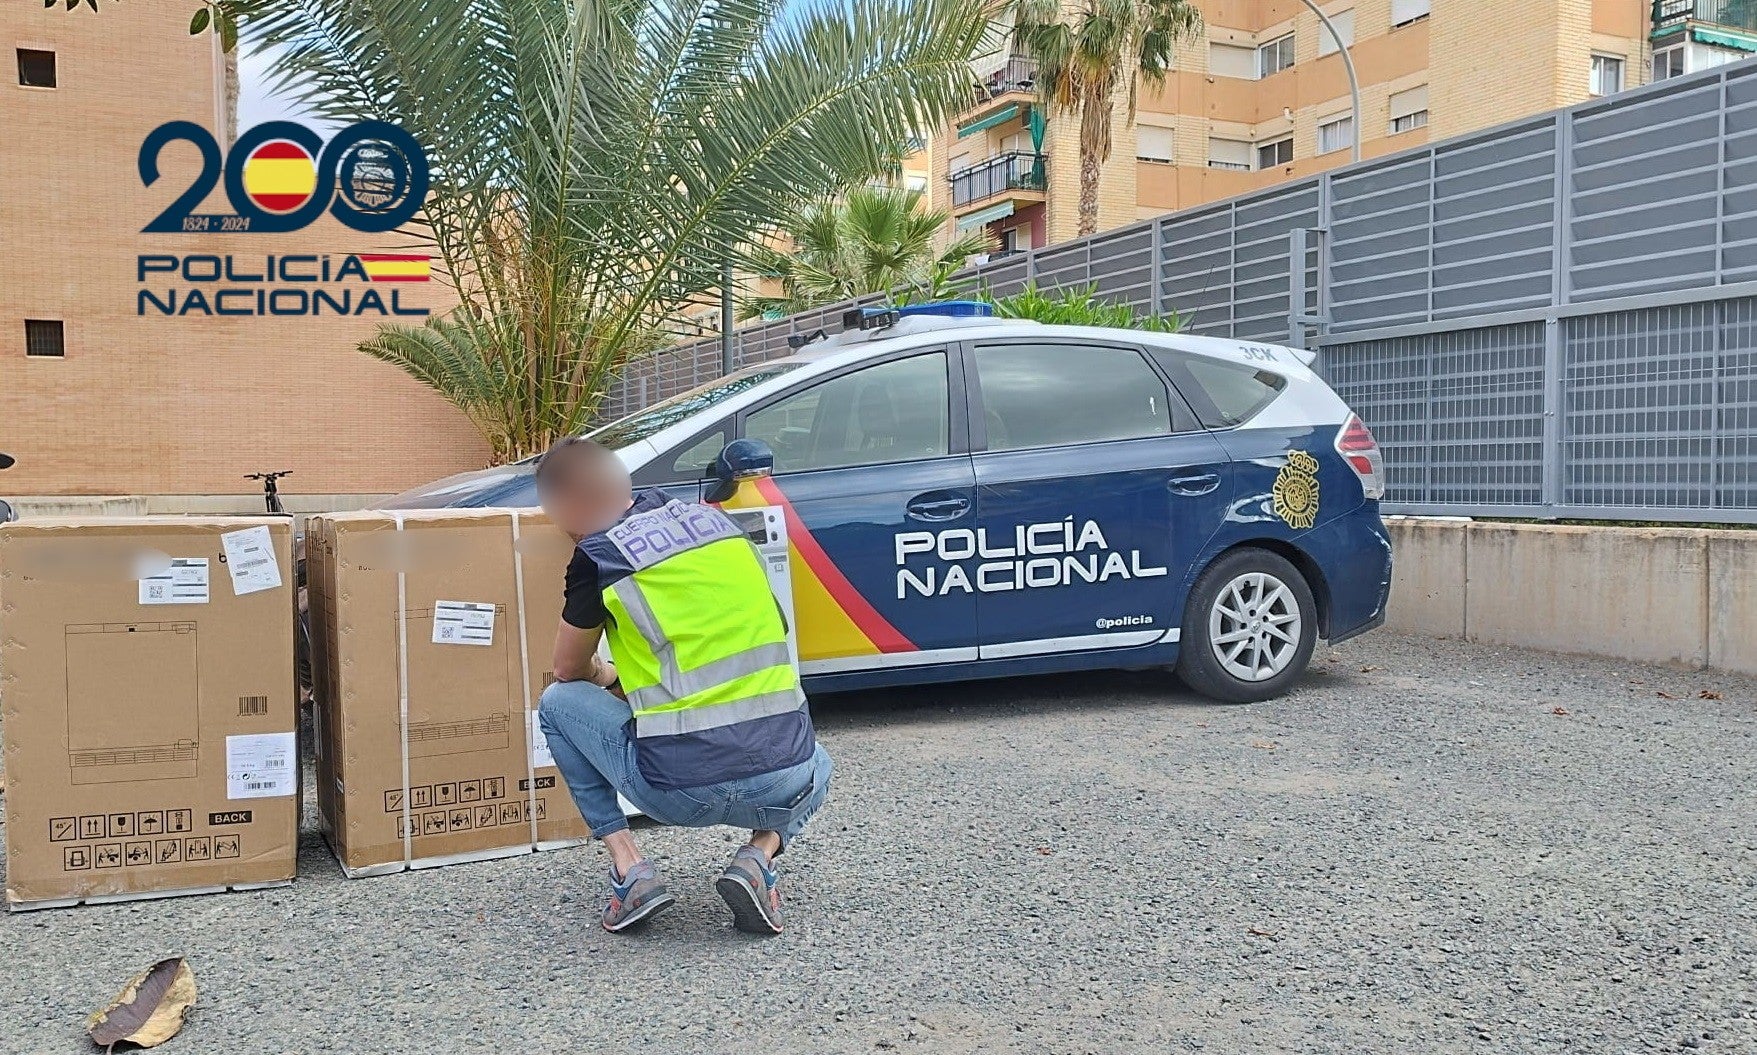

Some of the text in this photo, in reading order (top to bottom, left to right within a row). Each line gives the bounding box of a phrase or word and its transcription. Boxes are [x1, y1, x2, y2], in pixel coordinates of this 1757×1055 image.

[895, 515, 1108, 565] POLICÍA
[897, 550, 1168, 599] NACIONAL
[1095, 615, 1153, 629] @policia
[214, 813, 247, 823] BACK
